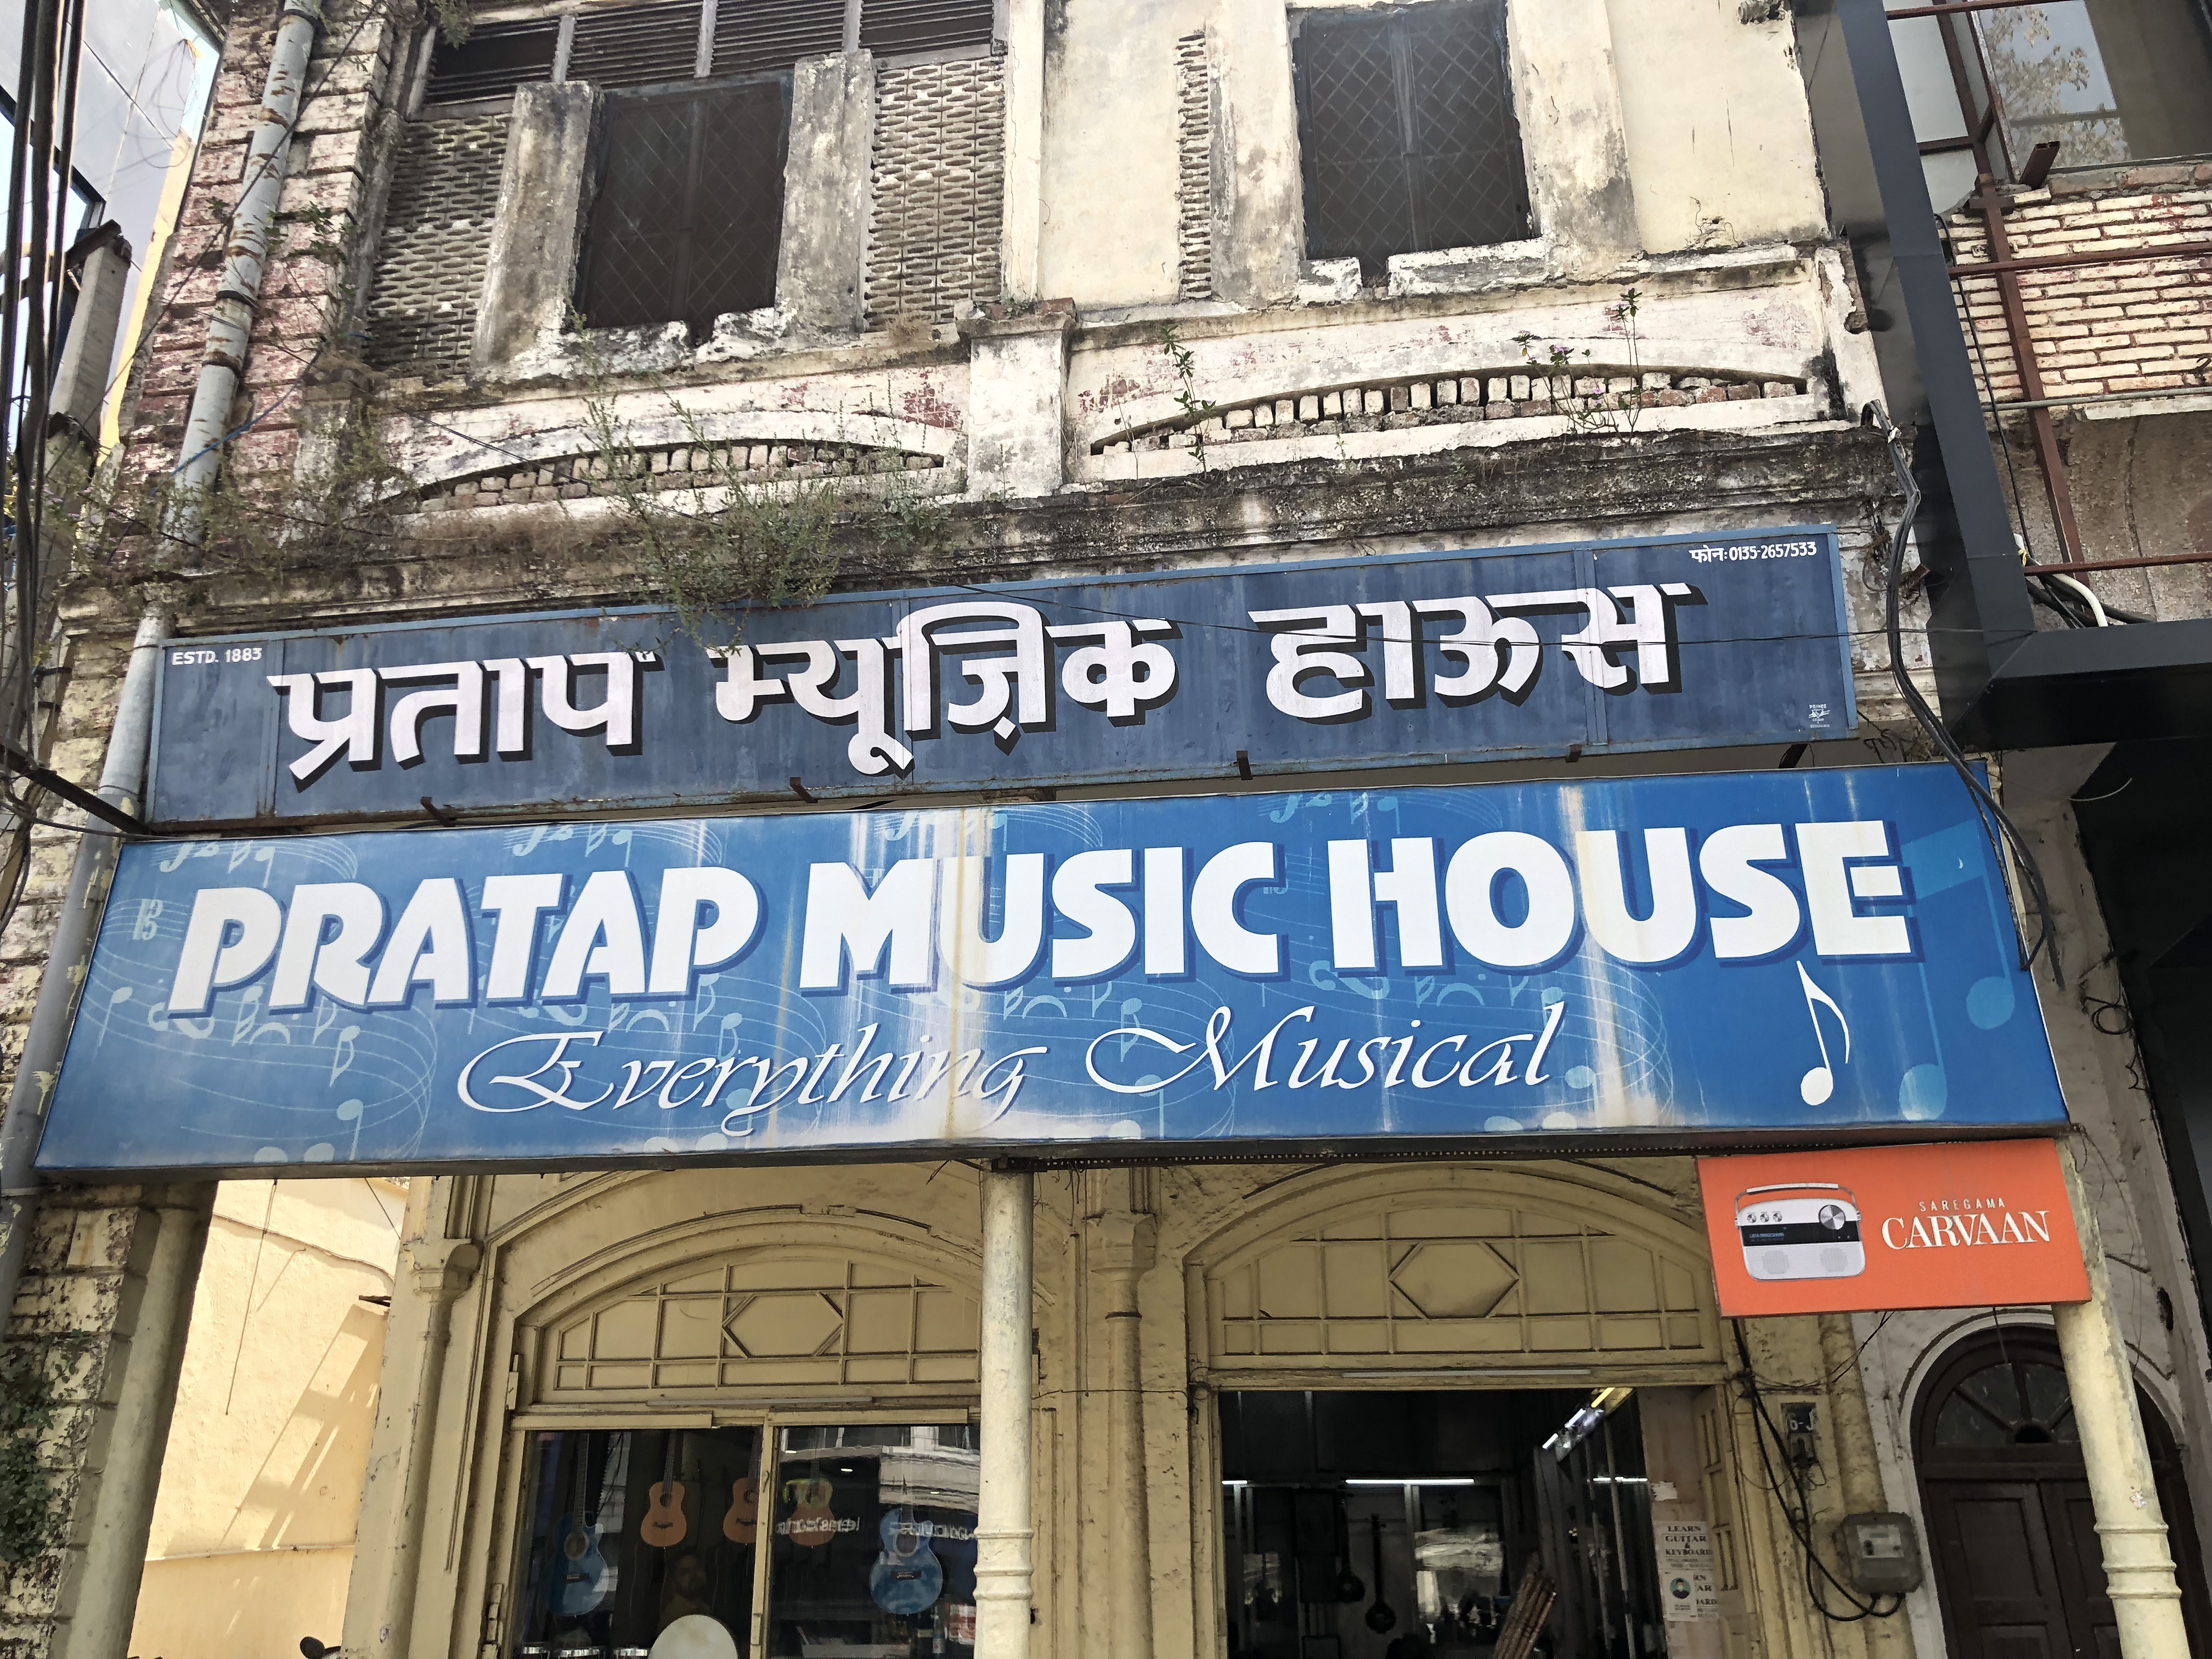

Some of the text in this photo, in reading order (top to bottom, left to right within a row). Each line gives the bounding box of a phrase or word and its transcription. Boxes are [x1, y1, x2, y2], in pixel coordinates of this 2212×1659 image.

[172, 647, 262, 665] ESTD. 1883
[266, 582, 1694, 782] प्रताप म्यूज़िक हाऊस
[168, 820, 1913, 1013] PRATAP MUSIC HOUSE
[457, 1002, 1565, 1136] Everything Musical
[1882, 1210, 2050, 1250] CARVAAN
[1919, 1198, 2005, 1212] SAREGAMA
